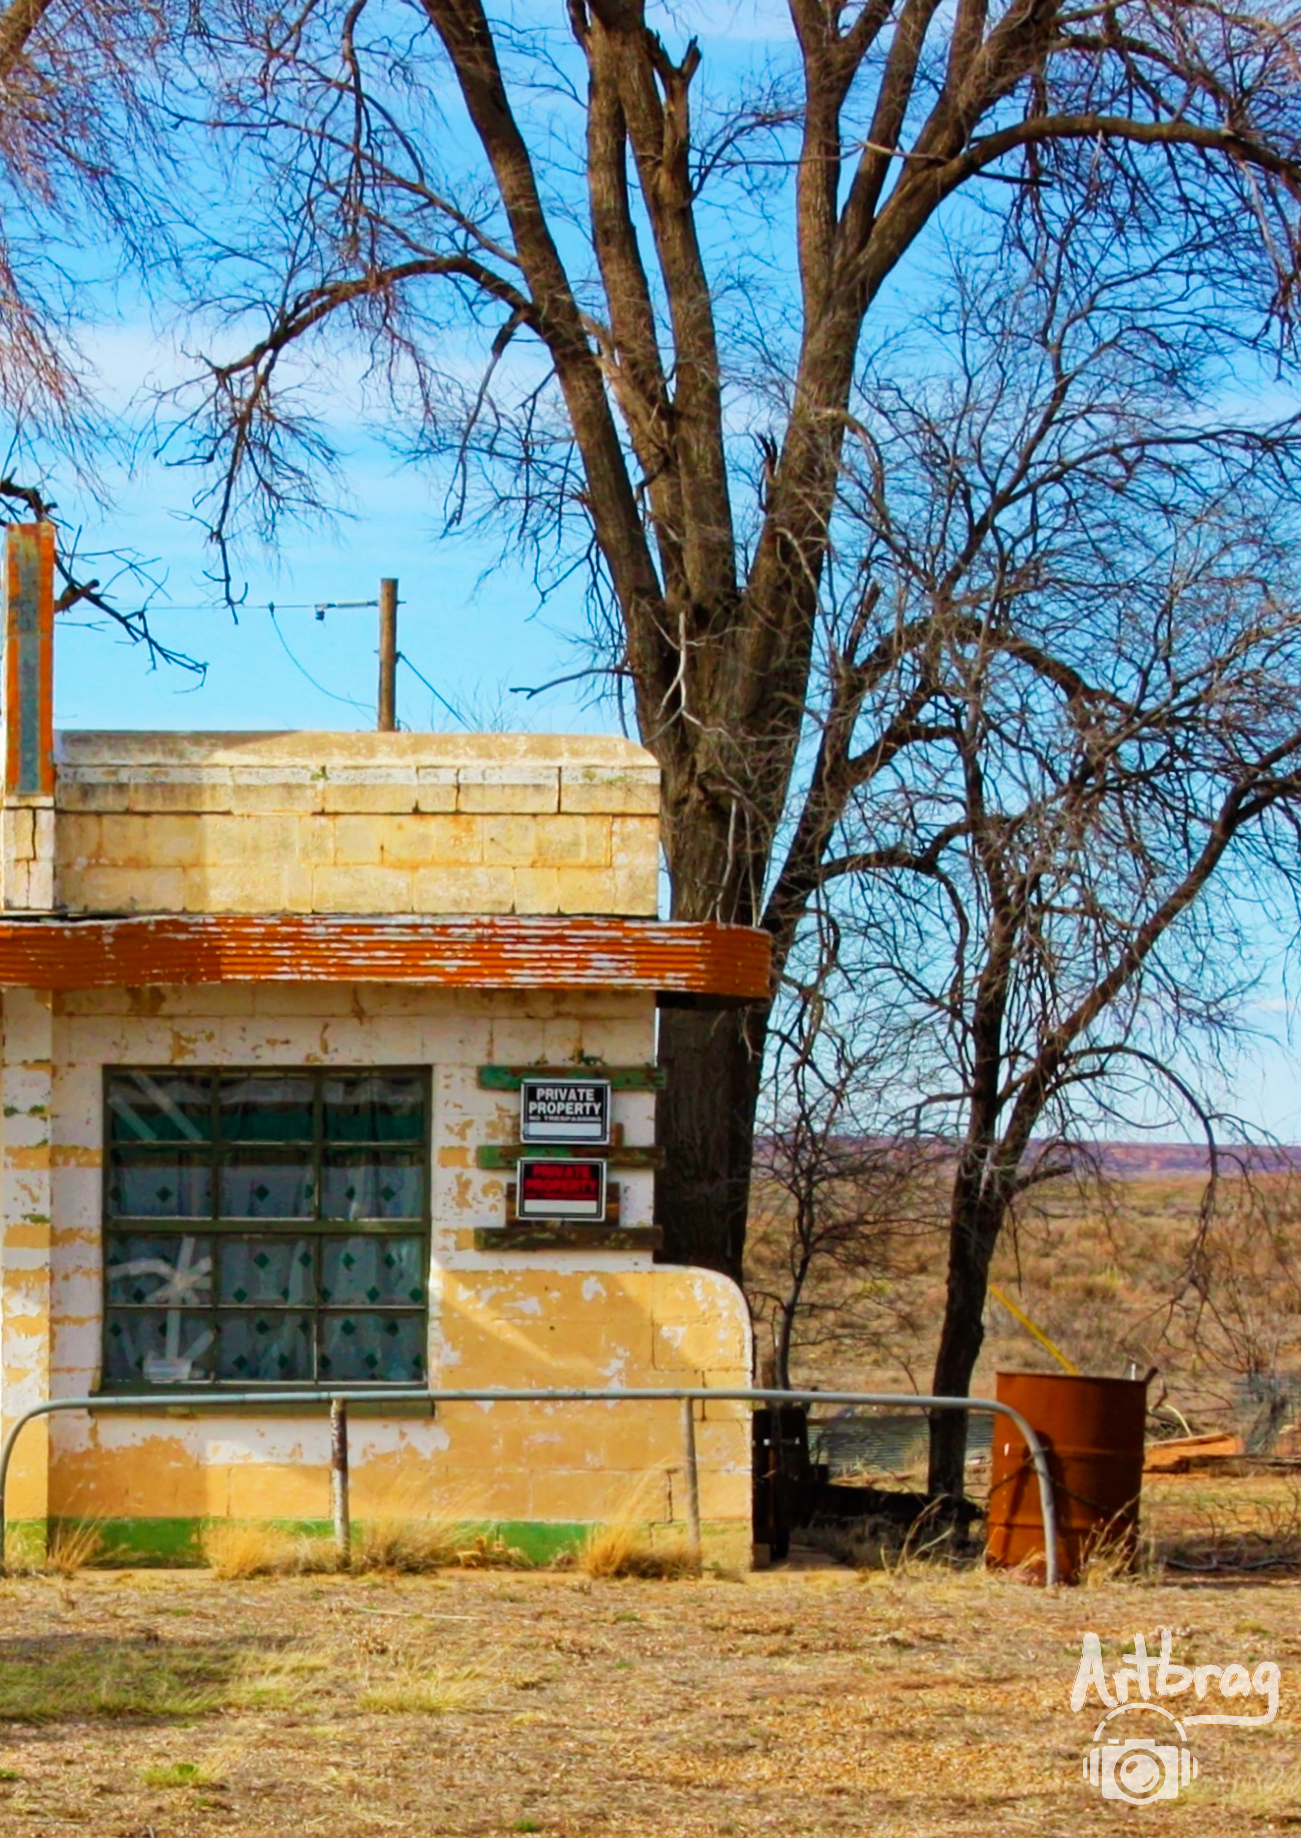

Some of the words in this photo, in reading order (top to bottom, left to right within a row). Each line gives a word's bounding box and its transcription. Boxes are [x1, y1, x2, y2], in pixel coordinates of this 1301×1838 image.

[536, 1088, 595, 1101] PRIVATE
[528, 1101, 602, 1115] PROPERTY
[532, 1165, 590, 1178] PRIVATE
[525, 1178, 597, 1192] PROPERTY
